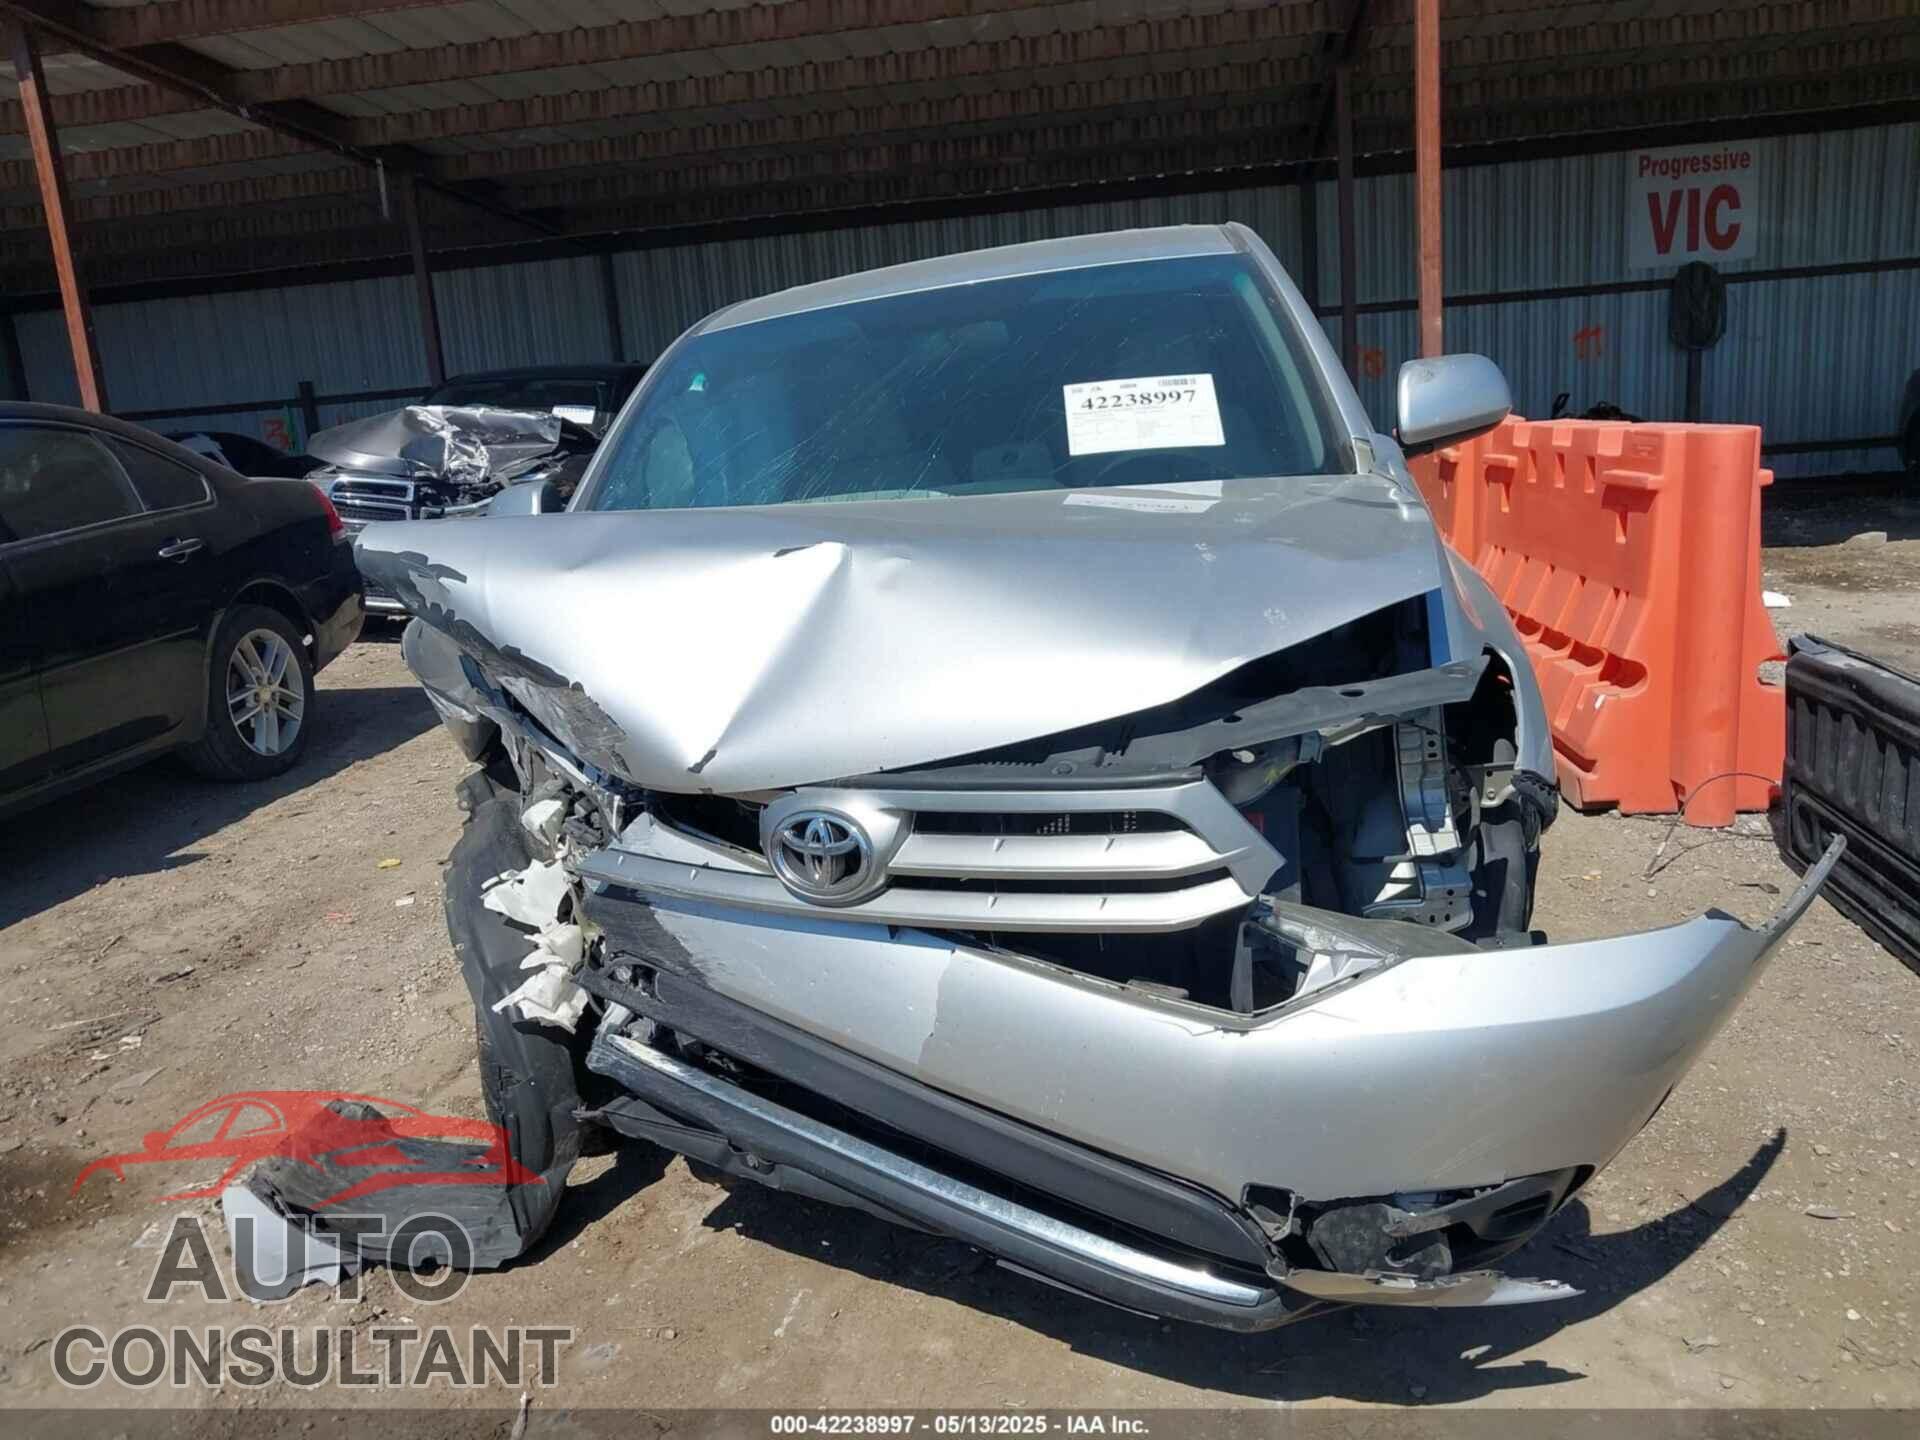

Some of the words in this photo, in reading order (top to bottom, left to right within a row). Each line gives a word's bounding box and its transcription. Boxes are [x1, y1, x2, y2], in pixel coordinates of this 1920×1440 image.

[1638, 148, 1751, 180] Progressive
[1647, 183, 1742, 255] VIC
[1081, 389, 1197, 410] 42238997
